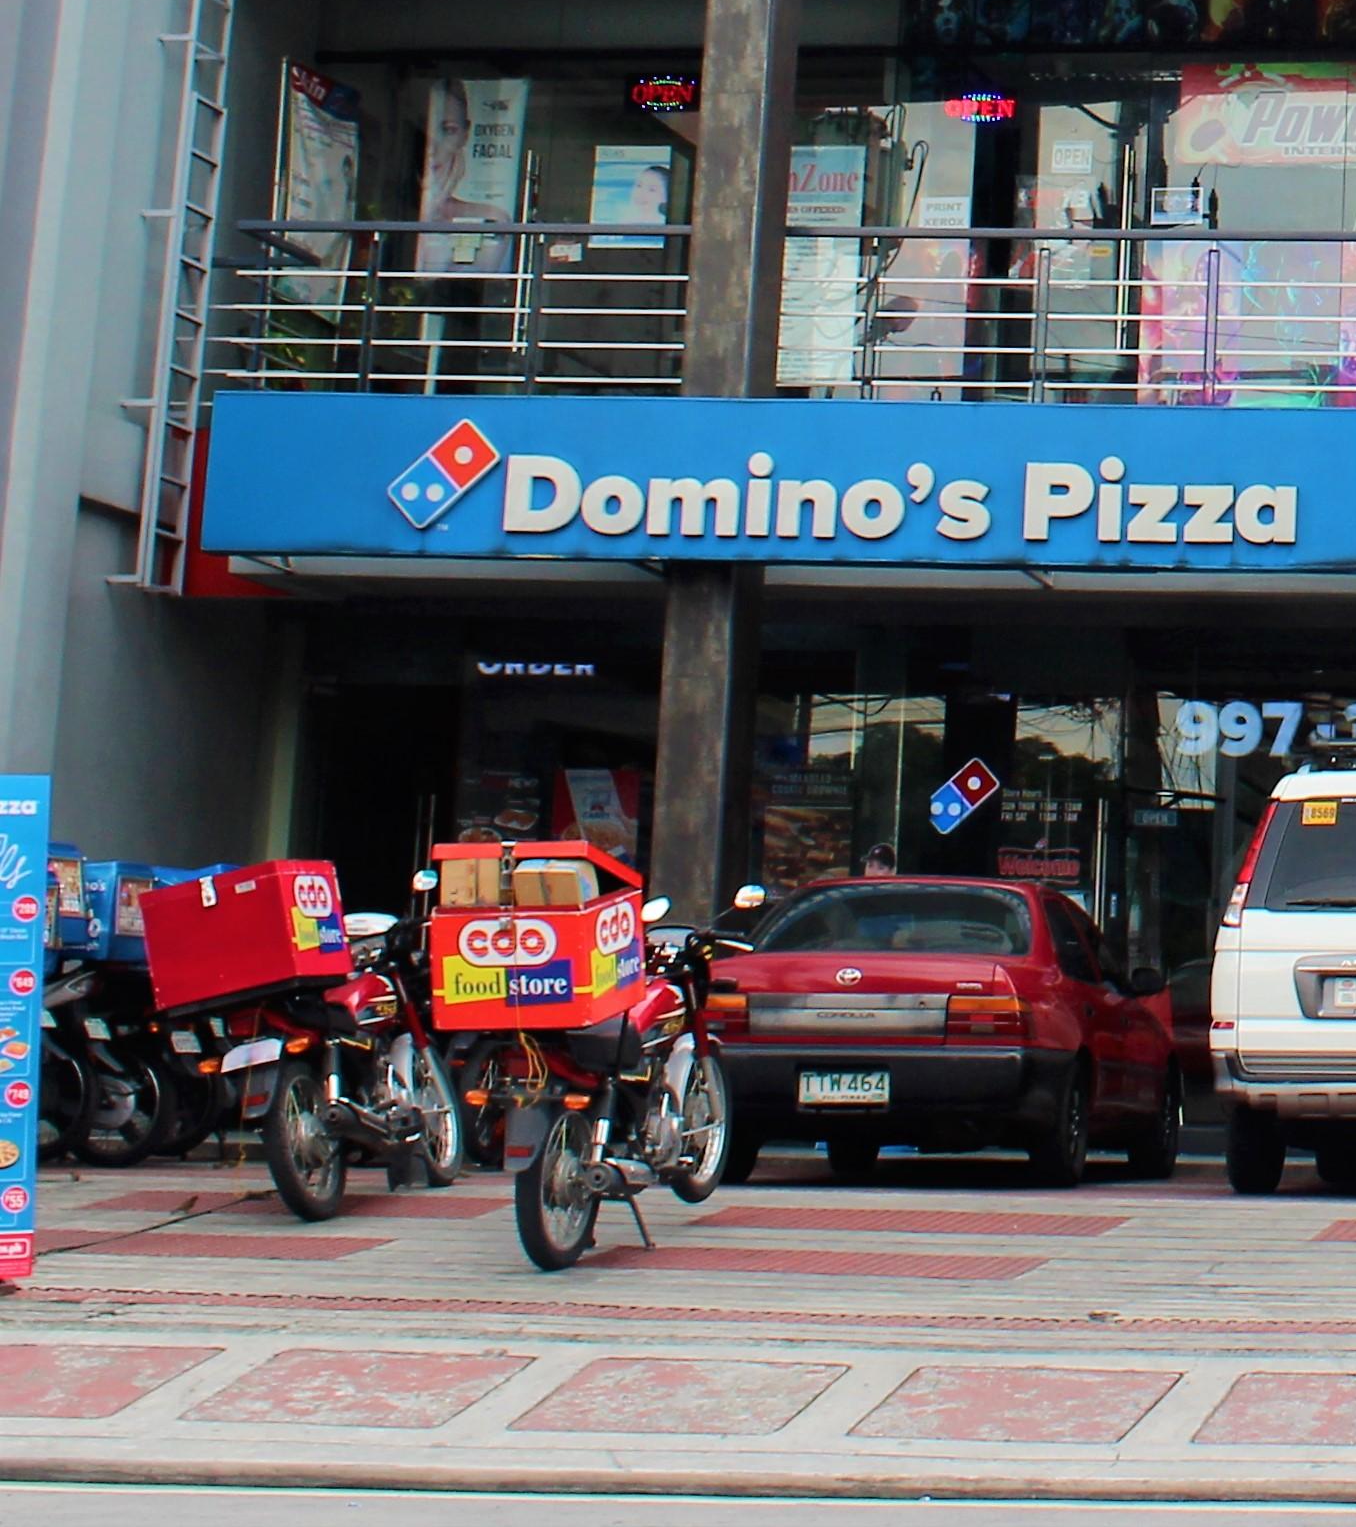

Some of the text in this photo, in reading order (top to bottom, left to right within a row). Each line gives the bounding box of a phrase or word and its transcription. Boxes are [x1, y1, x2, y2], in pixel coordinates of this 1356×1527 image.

[631, 84, 694, 104] OPEN
[944, 99, 1015, 118] OPEN
[472, 143, 513, 158] FACIAL
[1055, 148, 1091, 166] OPEN
[925, 202, 963, 212] PRINT
[924, 217, 966, 226] XEROX
[504, 453, 1299, 546] Domino's Pizza
[454, 972, 568, 996] food store
[803, 1074, 886, 1093] TTW 464
